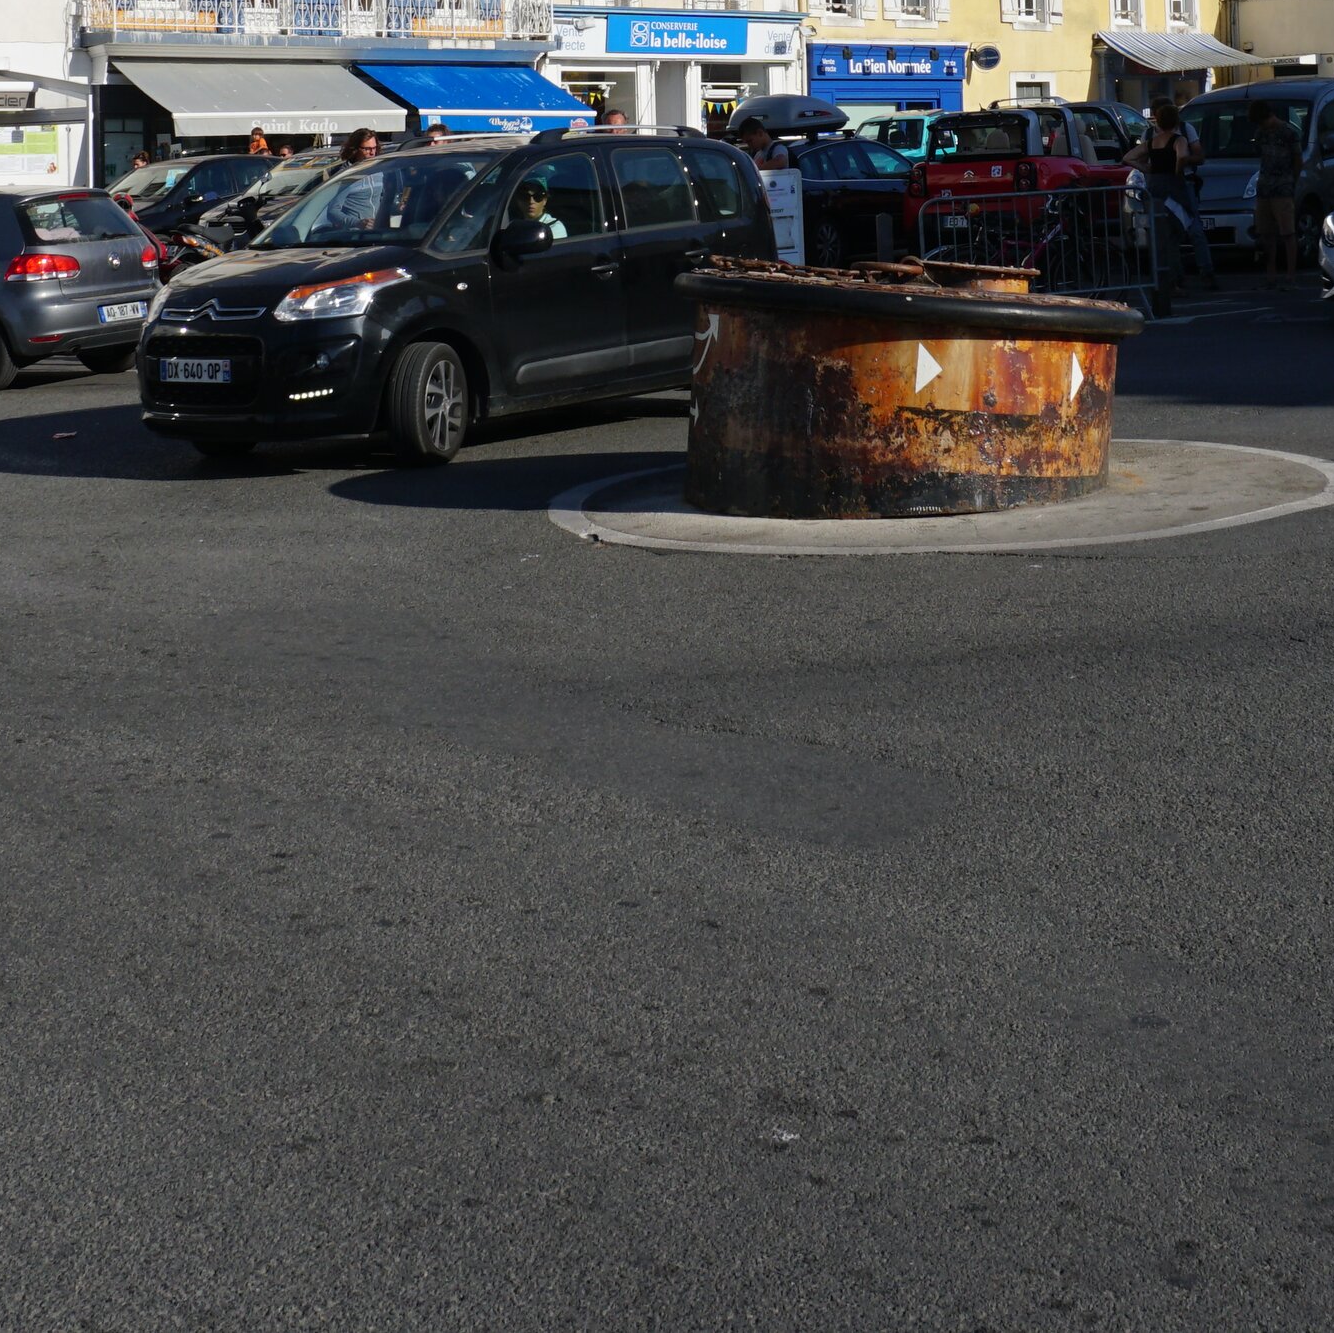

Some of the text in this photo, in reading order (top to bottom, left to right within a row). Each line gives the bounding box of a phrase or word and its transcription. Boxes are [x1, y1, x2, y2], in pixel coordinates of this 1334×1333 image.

[651, 22, 698, 31] CONSERVERIE
[650, 32, 728, 49] la belle-iloise
[767, 30, 792, 42] Vente
[849, 59, 863, 73] La
[864, 59, 886, 73] Bien
[887, 59, 932, 73] Nommée
[251, 118, 338, 132] Saint Kado
